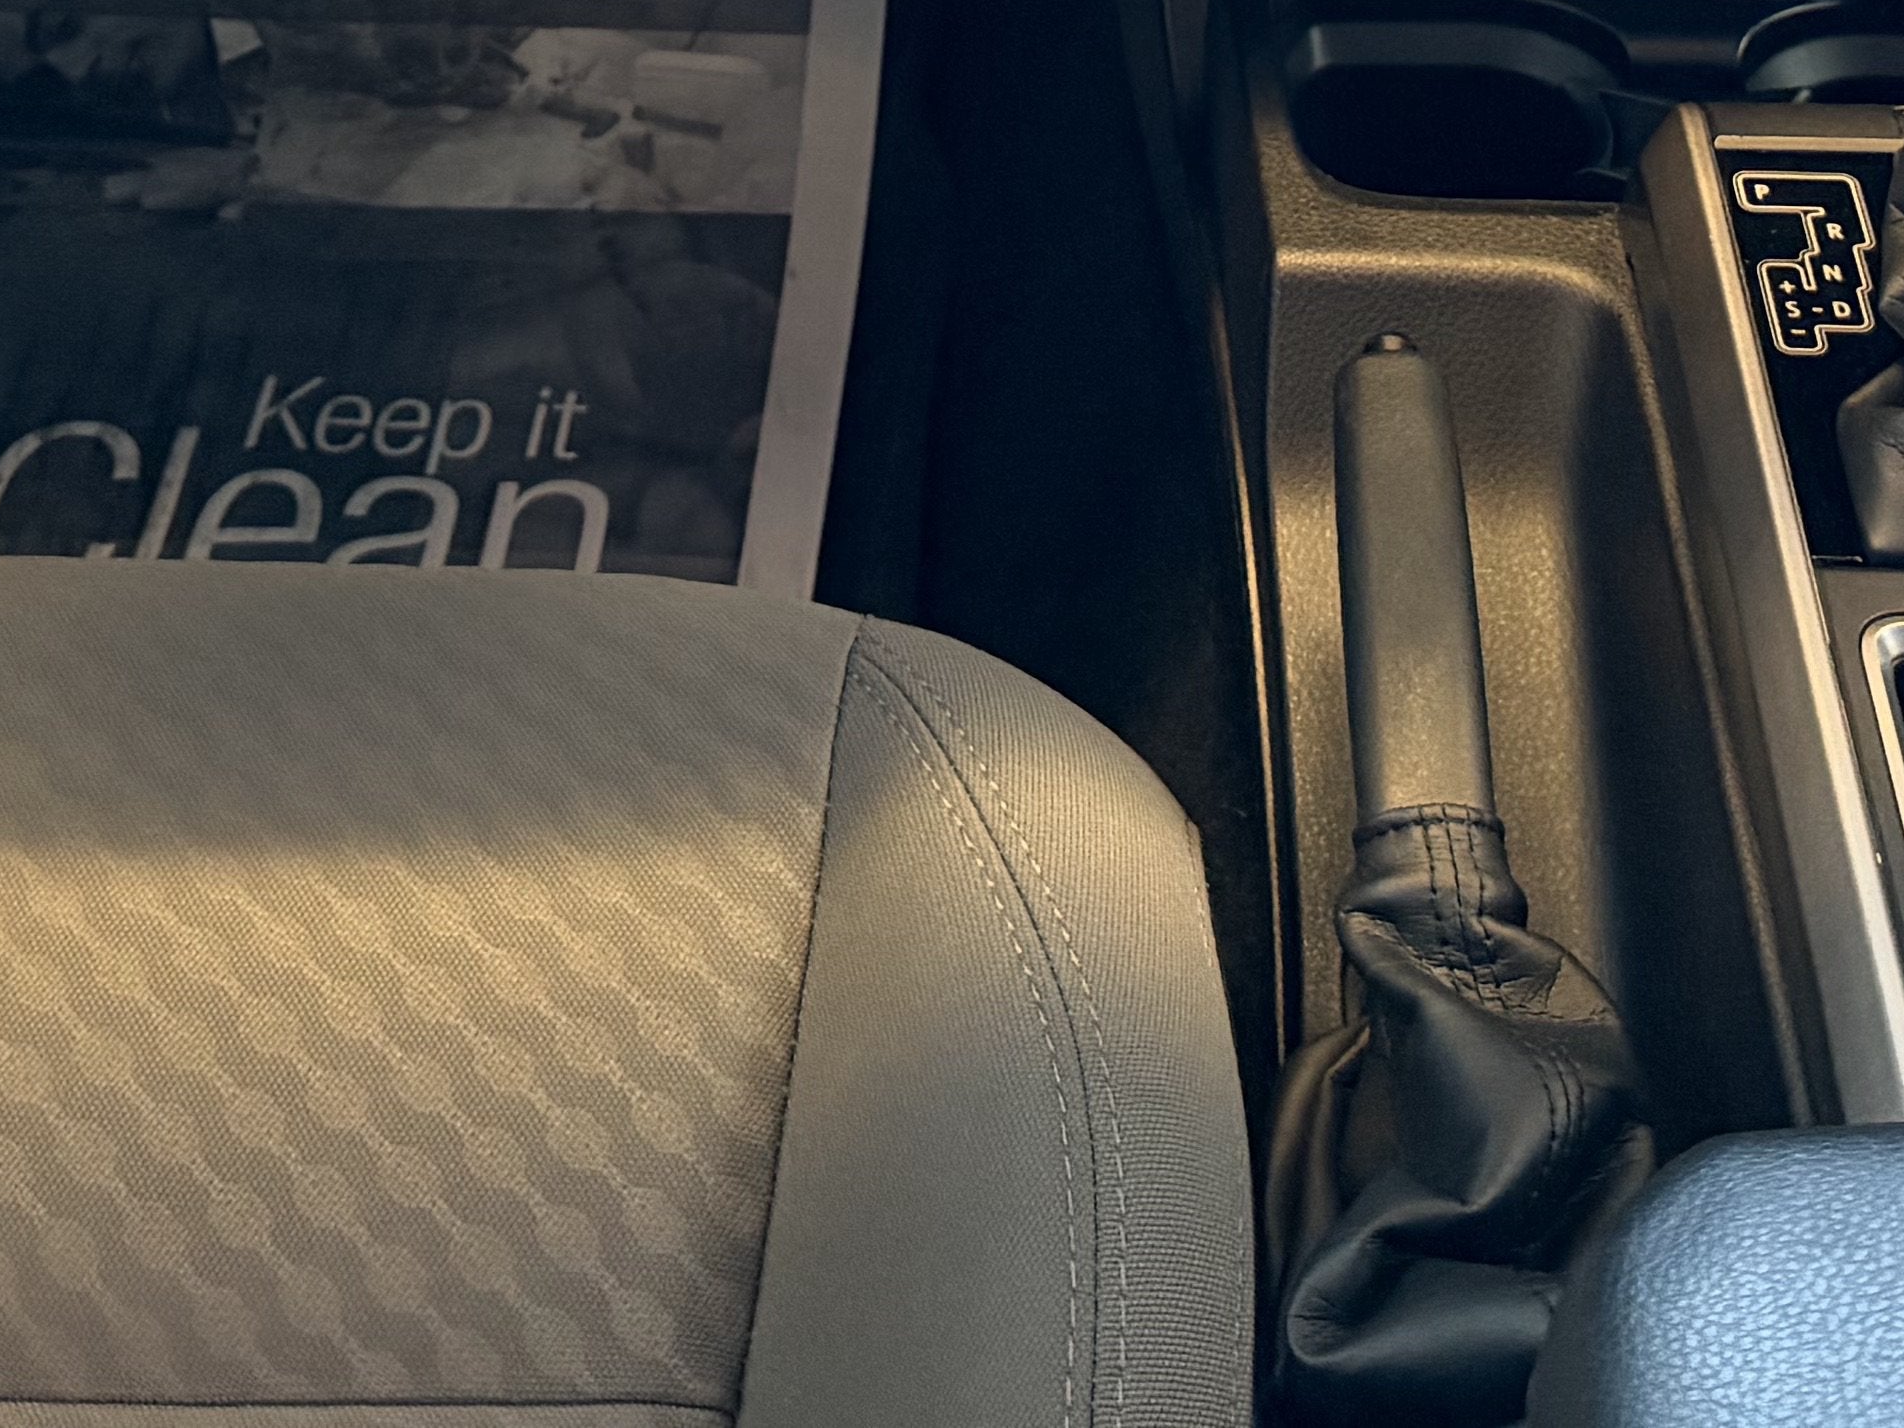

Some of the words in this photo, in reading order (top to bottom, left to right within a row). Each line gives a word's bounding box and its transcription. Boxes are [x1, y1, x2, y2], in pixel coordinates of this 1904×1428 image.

[1753, 183, 1771, 200] P
[1826, 222, 1845, 241] R
[1822, 264, 1844, 283] N
[1784, 300, 1802, 319] S
[1831, 300, 1852, 319] D
[244, 374, 493, 475] Keep
[525, 385, 588, 460] it
